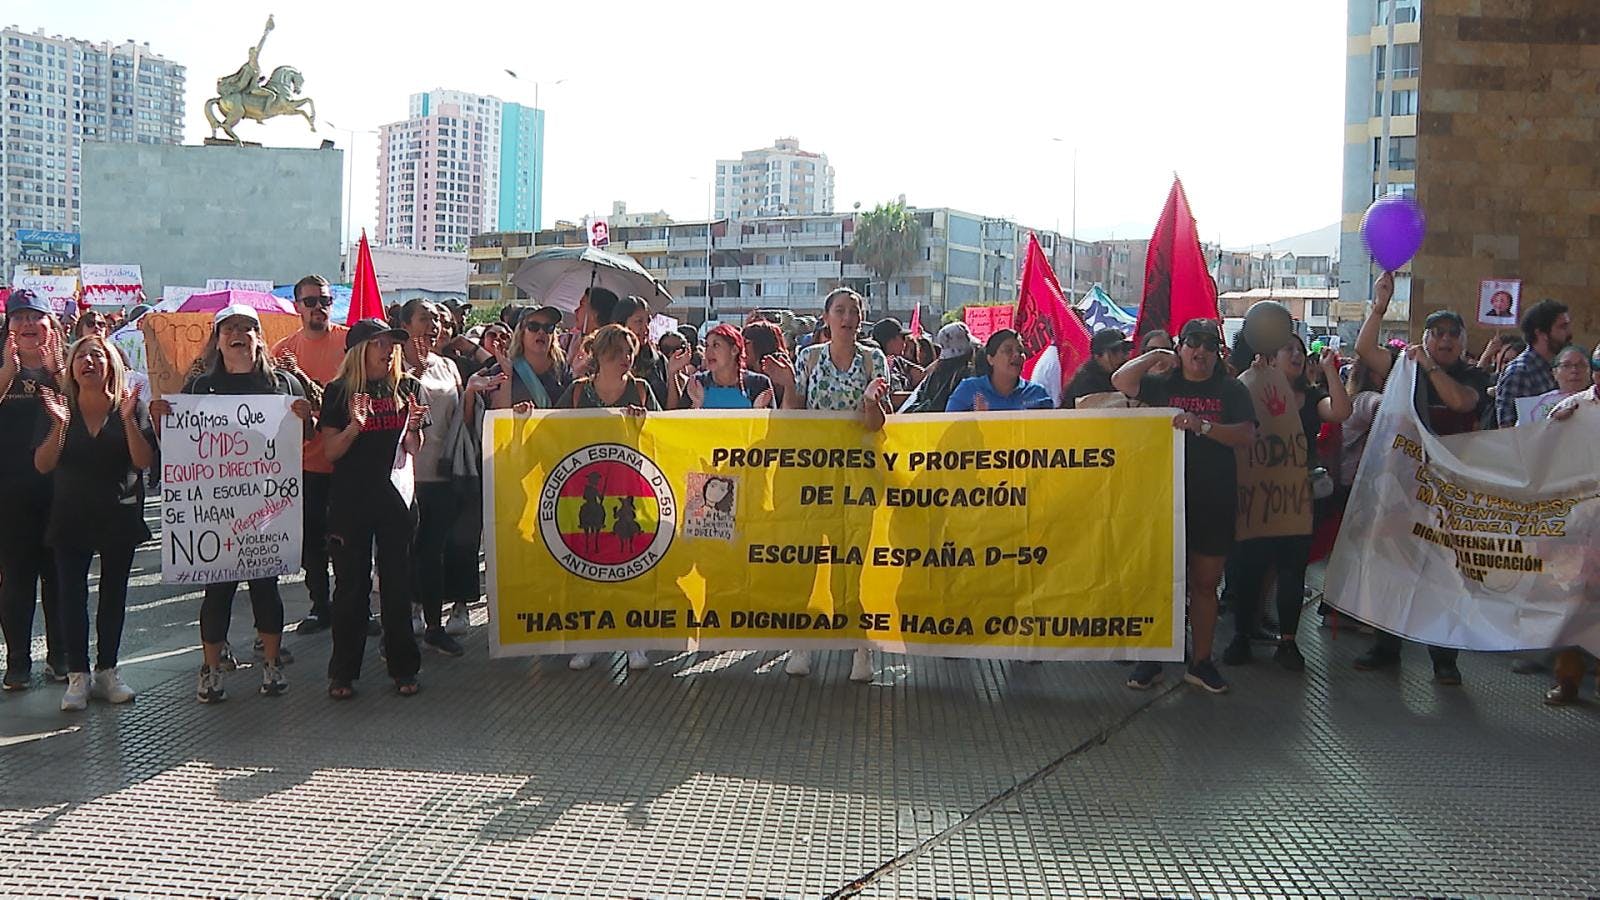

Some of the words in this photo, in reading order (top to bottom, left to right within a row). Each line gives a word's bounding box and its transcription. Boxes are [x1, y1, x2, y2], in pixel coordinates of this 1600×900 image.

[166, 402, 229, 442] Exigimos
[237, 403, 265, 428] Que
[198, 431, 249, 459] CMDS
[712, 447, 876, 468] PROFESORES
[883, 453, 899, 471] Y
[909, 448, 1116, 470] PROFESIONALES
[164, 488, 185, 502] DE
[187, 486, 203, 501] LA
[213, 483, 261, 499] ESCUELA
[542, 458, 582, 521] ESCUELA
[588, 447, 645, 471] ESPAÑA
[652, 475, 673, 517] D-59
[800, 486, 833, 505] DE
[843, 486, 877, 506] LA
[886, 481, 1027, 507] EDUCACIÓN
[164, 507, 186, 524] SE
[193, 505, 235, 525] HAGAN
[171, 530, 221, 565] NO
[748, 545, 863, 565] ESCUELA
[872, 542, 976, 567] ESPAÑA
[985, 547, 1048, 565] D-59
[236, 556, 283, 570] ABUSOS
[561, 551, 659, 579] ANTOFAGASTA
[1473, 551, 1543, 573] EDUCACIÓN
[517, 610, 615, 632] "HASTA
[626, 609, 676, 628] QUE
[687, 609, 721, 629] LA
[730, 610, 848, 630] DIGNIDAD
[859, 614, 890, 631] SE
[901, 614, 974, 636] HAGA
[984, 616, 1154, 637] COSTUMBRE"
